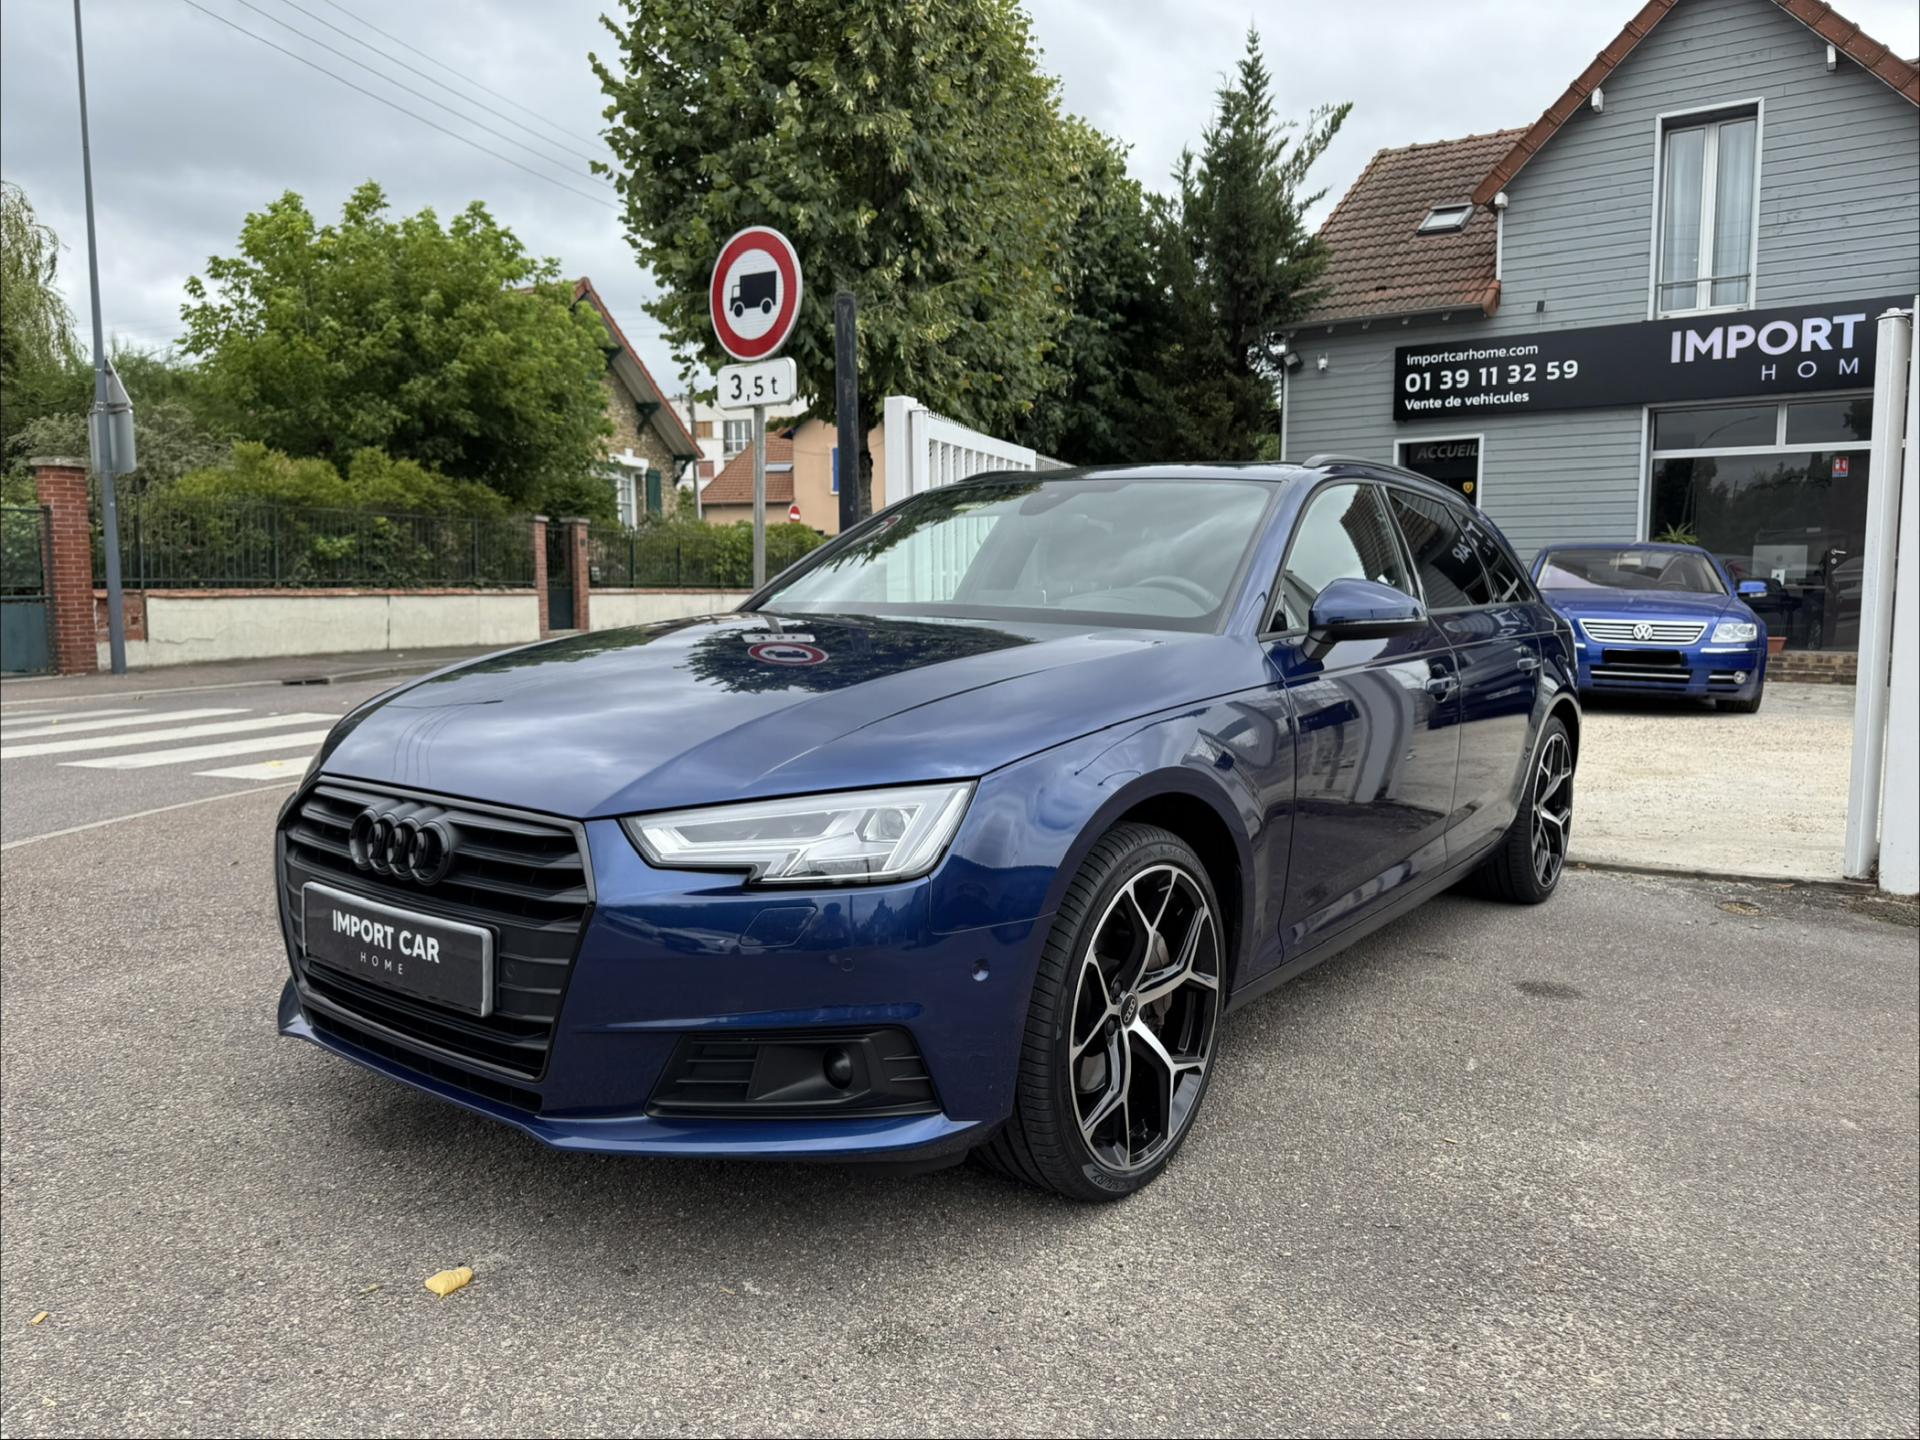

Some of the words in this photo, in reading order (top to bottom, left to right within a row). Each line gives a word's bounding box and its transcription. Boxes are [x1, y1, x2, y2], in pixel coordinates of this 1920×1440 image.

[1671, 313, 1866, 363] IMPORT
[1407, 345, 1538, 367] importcarhome.com
[1405, 372, 1431, 393] 01
[1440, 369, 1469, 390] 39
[1479, 366, 1498, 386] 11
[1507, 363, 1537, 384] 32
[1546, 360, 1578, 380] 59
[1761, 357, 1859, 381] HOM
[730, 374, 764, 401] 3,5
[771, 376, 778, 395] t
[1405, 398, 1442, 410] Vente
[1445, 396, 1461, 407] de
[1464, 391, 1529, 406] vehicules
[1416, 444, 1478, 460] ACCUEIL
[332, 909, 394, 949] IMPORT
[399, 930, 440, 963] CAR
[360, 952, 404, 975] HOME
